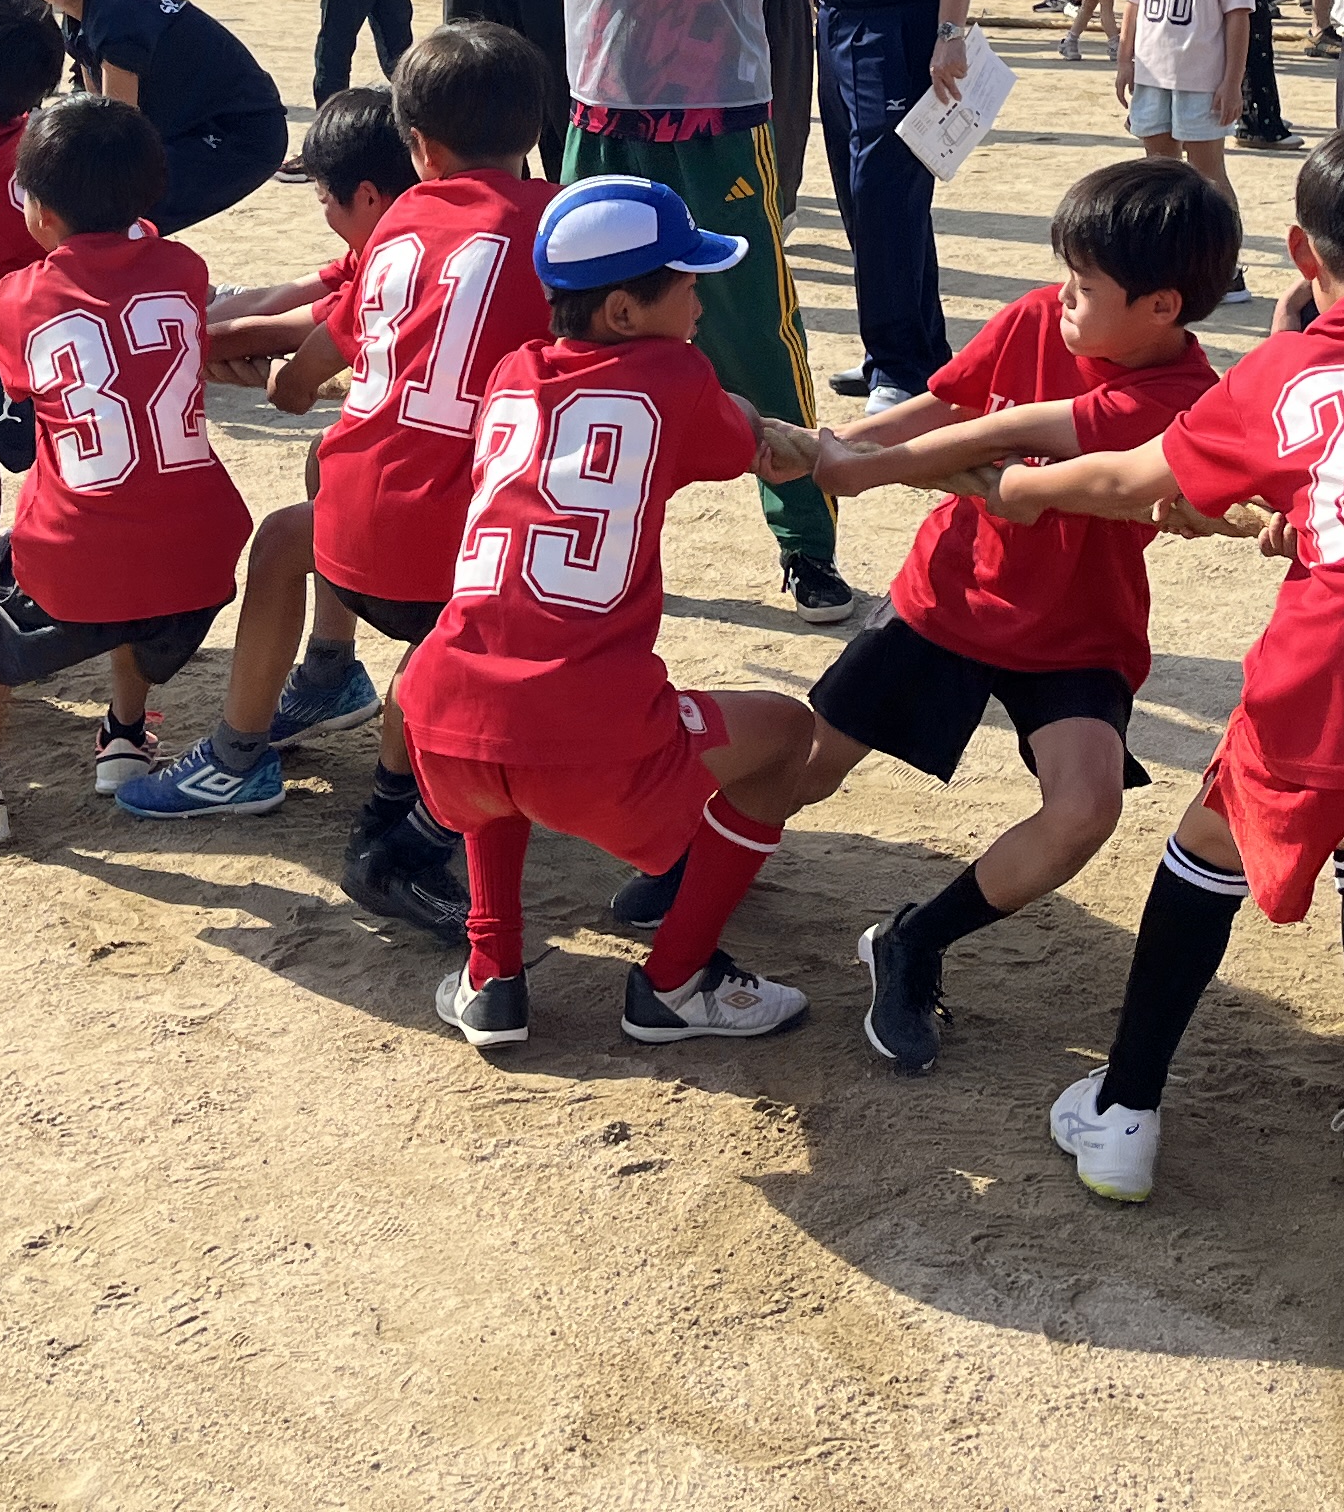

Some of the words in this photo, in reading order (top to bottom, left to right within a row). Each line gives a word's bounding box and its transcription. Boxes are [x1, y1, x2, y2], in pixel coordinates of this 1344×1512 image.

[24, 290, 215, 492] 32
[343, 231, 511, 439] 31
[453, 388, 662, 614] 29
